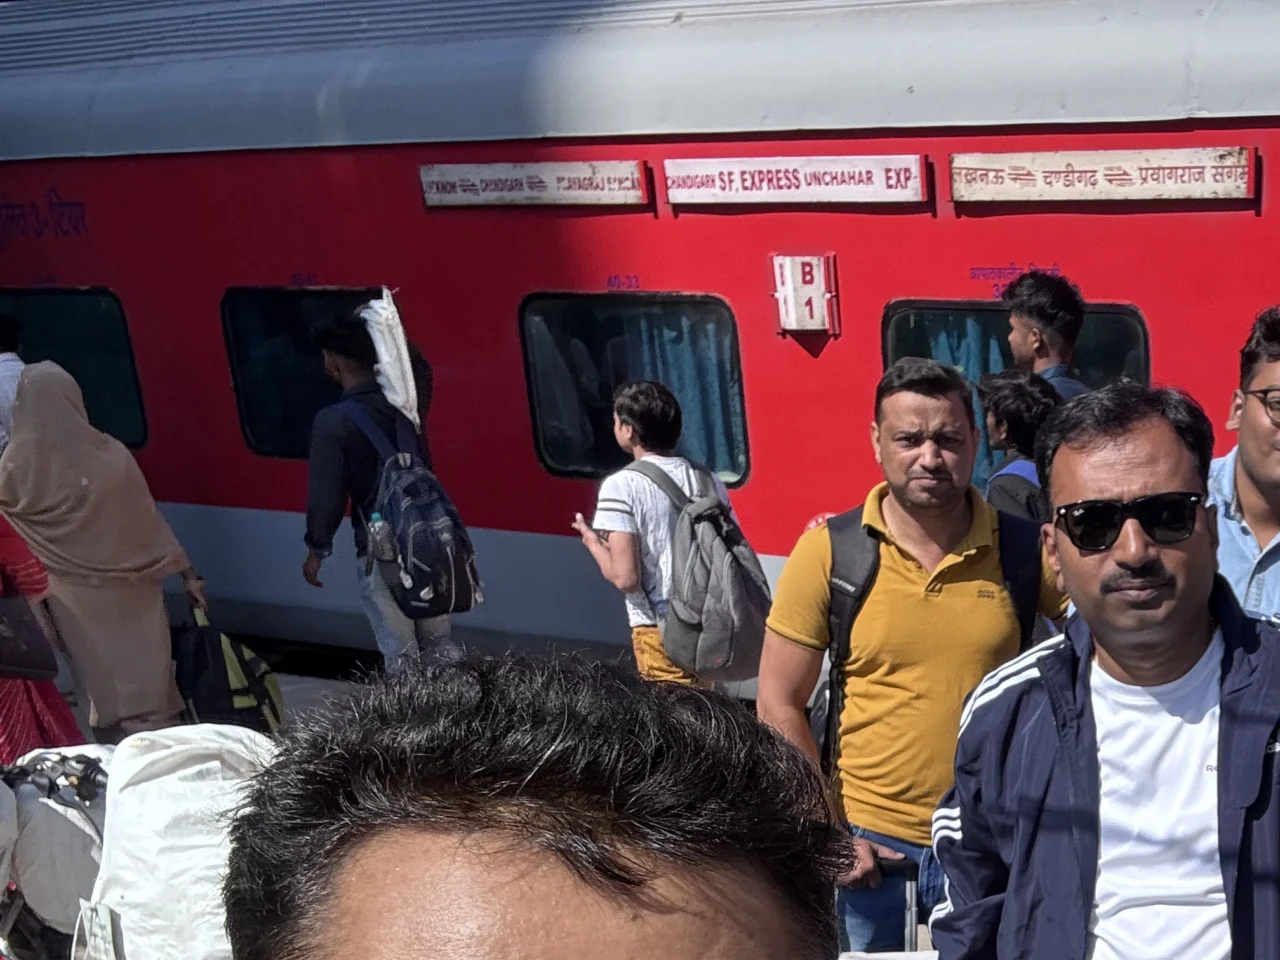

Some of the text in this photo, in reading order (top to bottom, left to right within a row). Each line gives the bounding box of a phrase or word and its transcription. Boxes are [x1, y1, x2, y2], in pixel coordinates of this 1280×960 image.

[740, 167, 801, 191] EXPRESS
[803, 169, 875, 187] UNCHAHAR
[801, 261, 815, 285] B
[804, 296, 814, 320] 1
